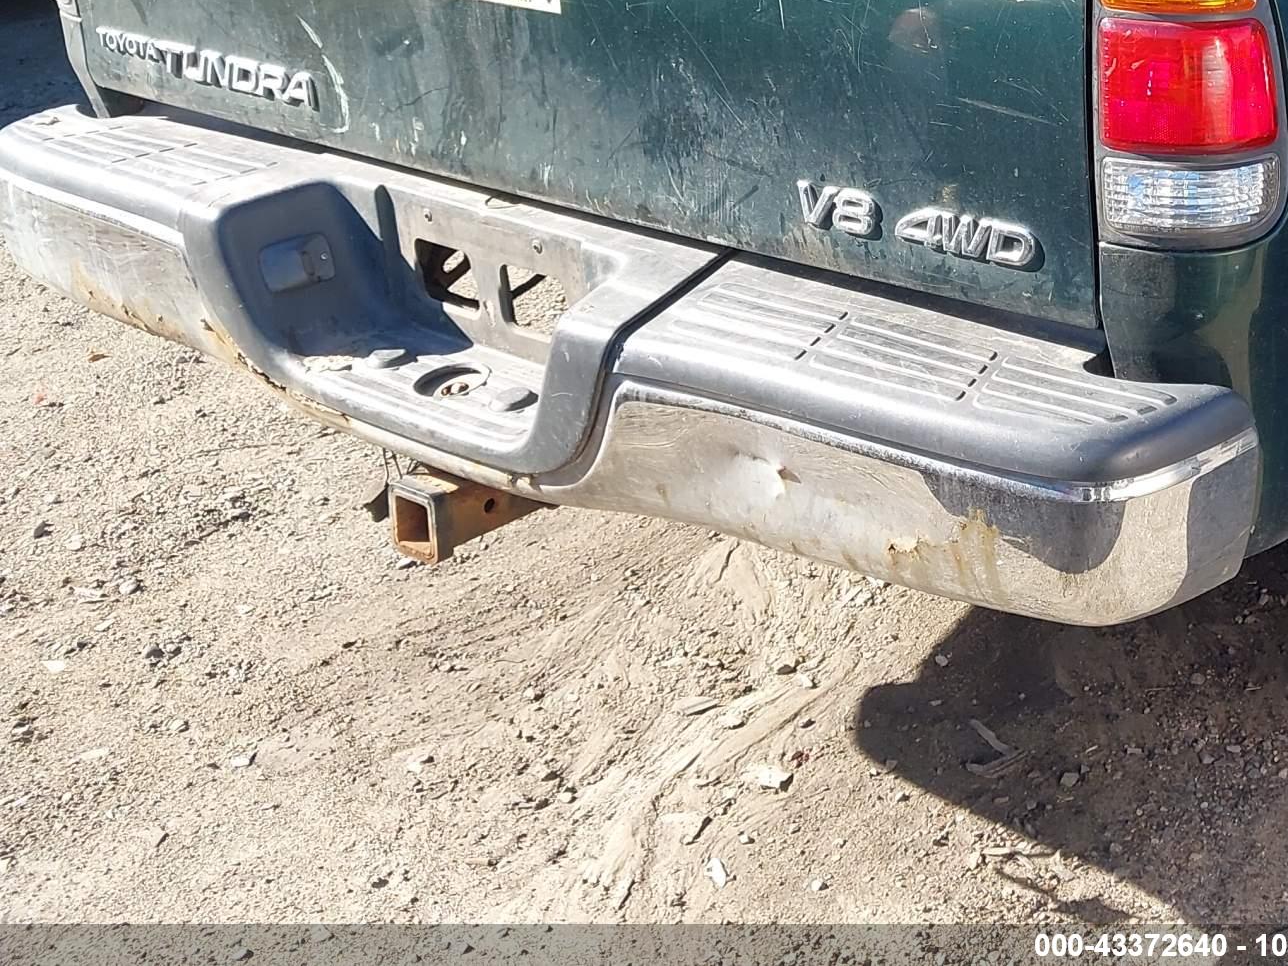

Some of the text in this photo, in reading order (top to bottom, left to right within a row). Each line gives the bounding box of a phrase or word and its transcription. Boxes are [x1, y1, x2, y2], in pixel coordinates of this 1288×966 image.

[96, 26, 318, 109] TOYOTA TUNDRA
[797, 179, 1040, 268] V8 4WD
